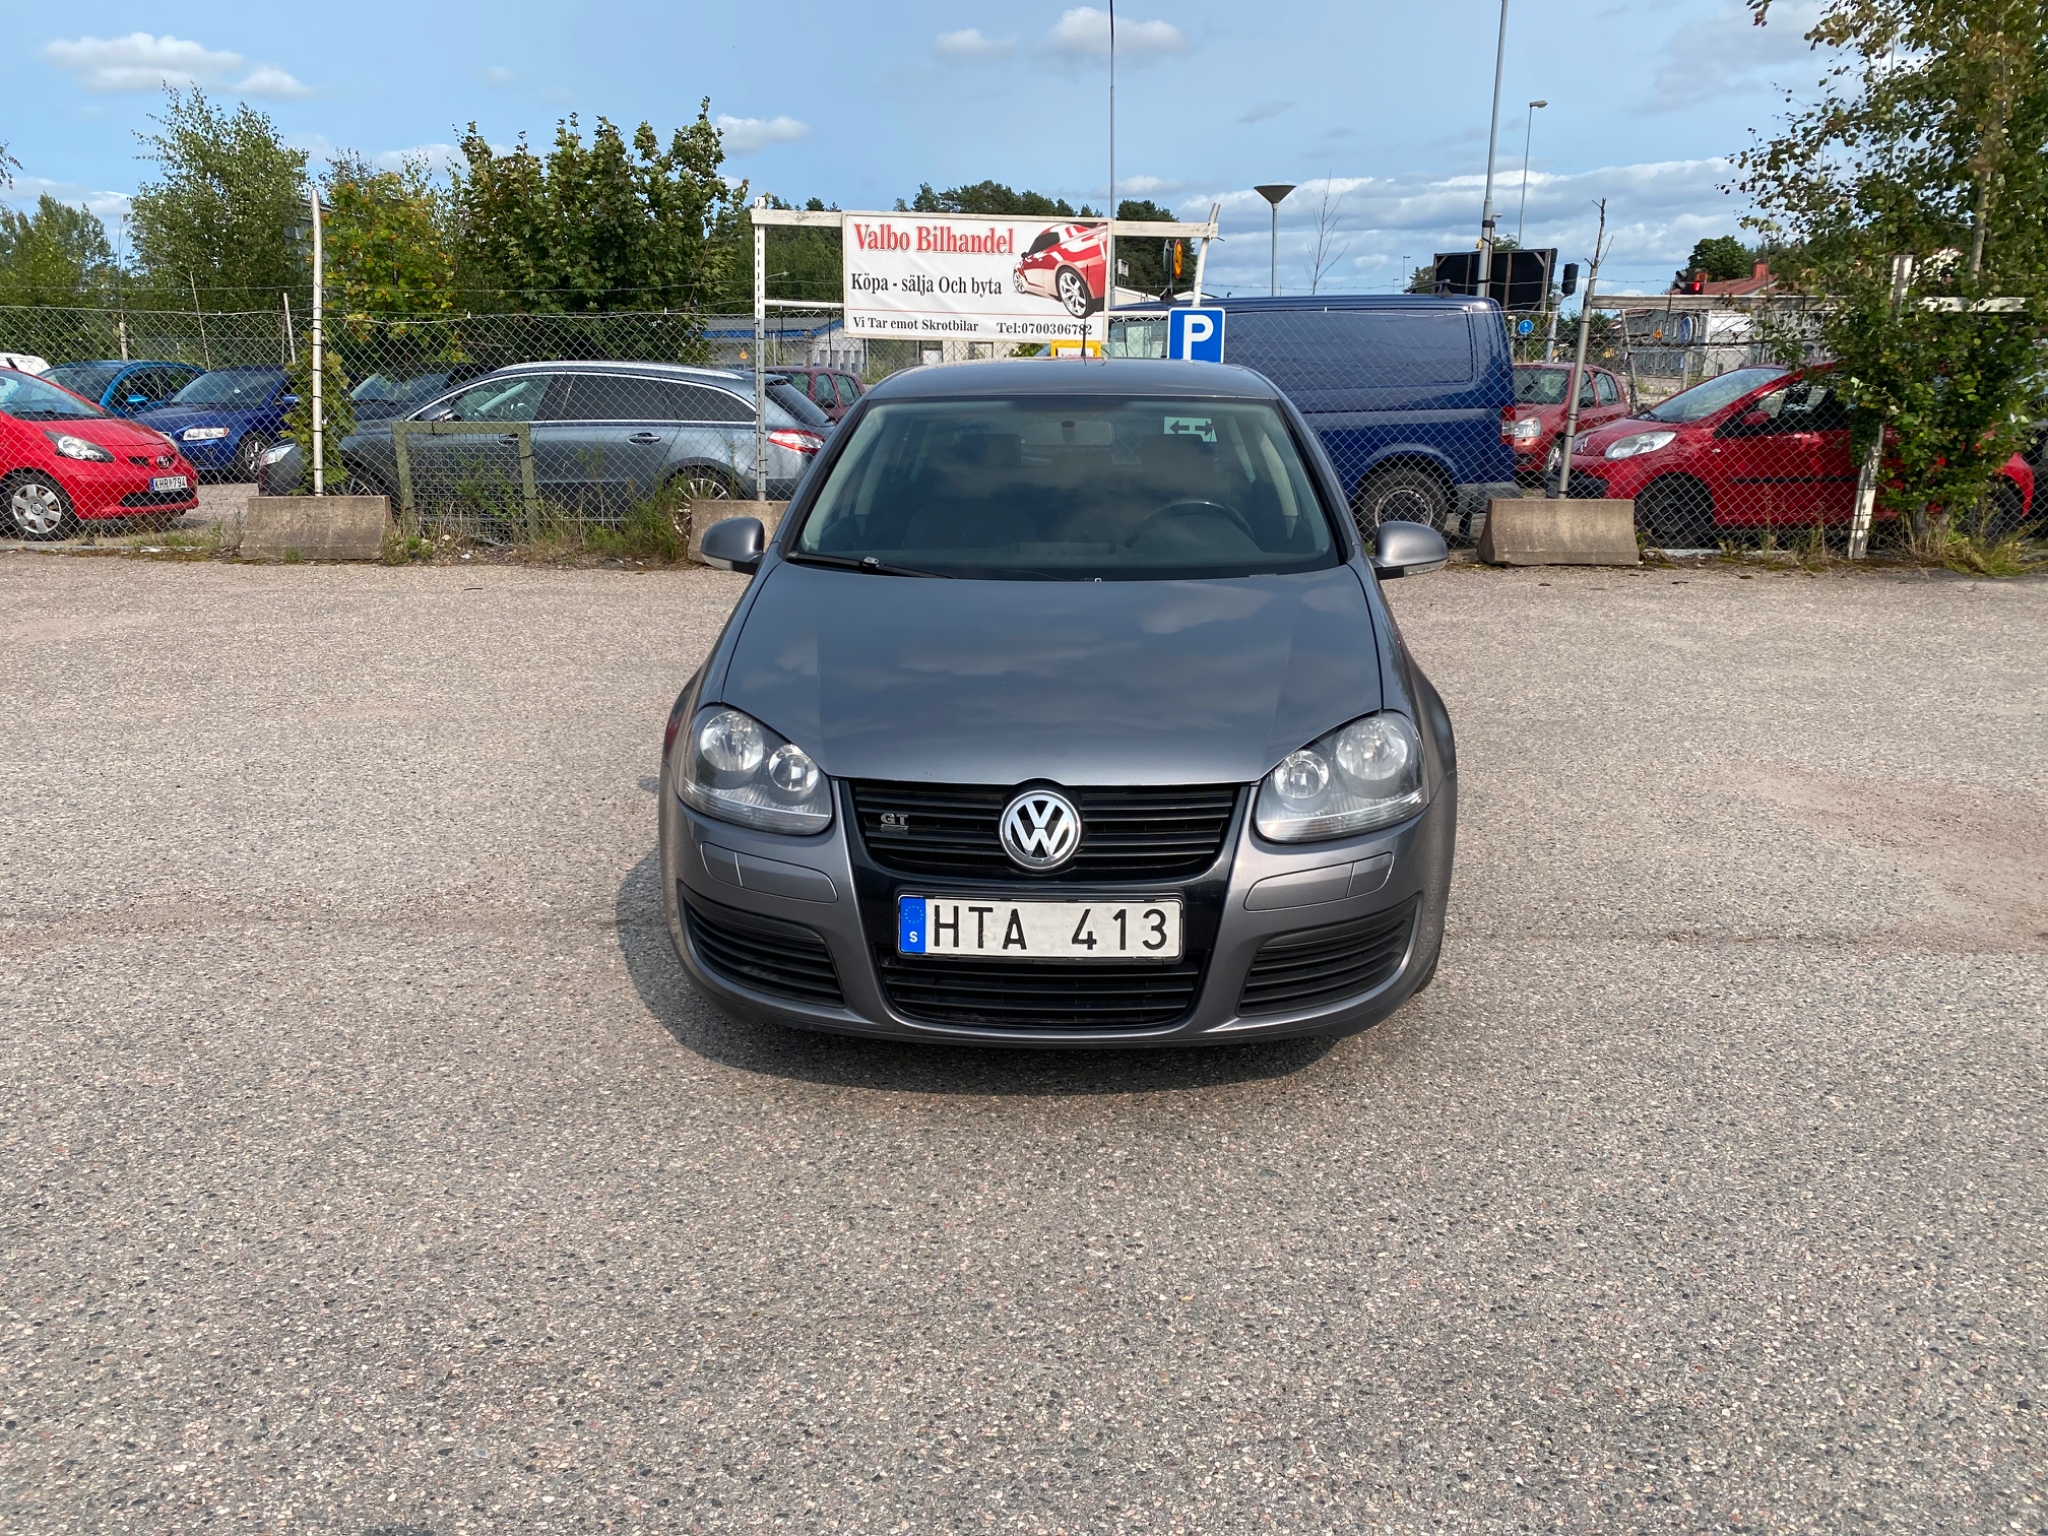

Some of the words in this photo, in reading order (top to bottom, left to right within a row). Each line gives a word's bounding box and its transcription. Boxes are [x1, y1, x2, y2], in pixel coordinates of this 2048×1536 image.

[854, 223, 910, 251] Valbo
[916, 225, 1014, 254] Bilhandel
[851, 272, 889, 294] Köpa
[901, 274, 934, 296] sälja
[938, 276, 967, 294] Och
[971, 277, 1002, 298] byta
[853, 316, 865, 328] Vi
[867, 317, 887, 329] Tar
[890, 319, 918, 330] emot
[921, 319, 979, 332] Skrotbilar
[996, 322, 1093, 336] Tel:0700306782
[1183, 314, 1214, 360] P
[880, 812, 909, 826] GT
[1004, 795, 1078, 864] VW
[909, 931, 918, 943] S
[933, 904, 1028, 950] HTA
[1071, 908, 1168, 951] 413
